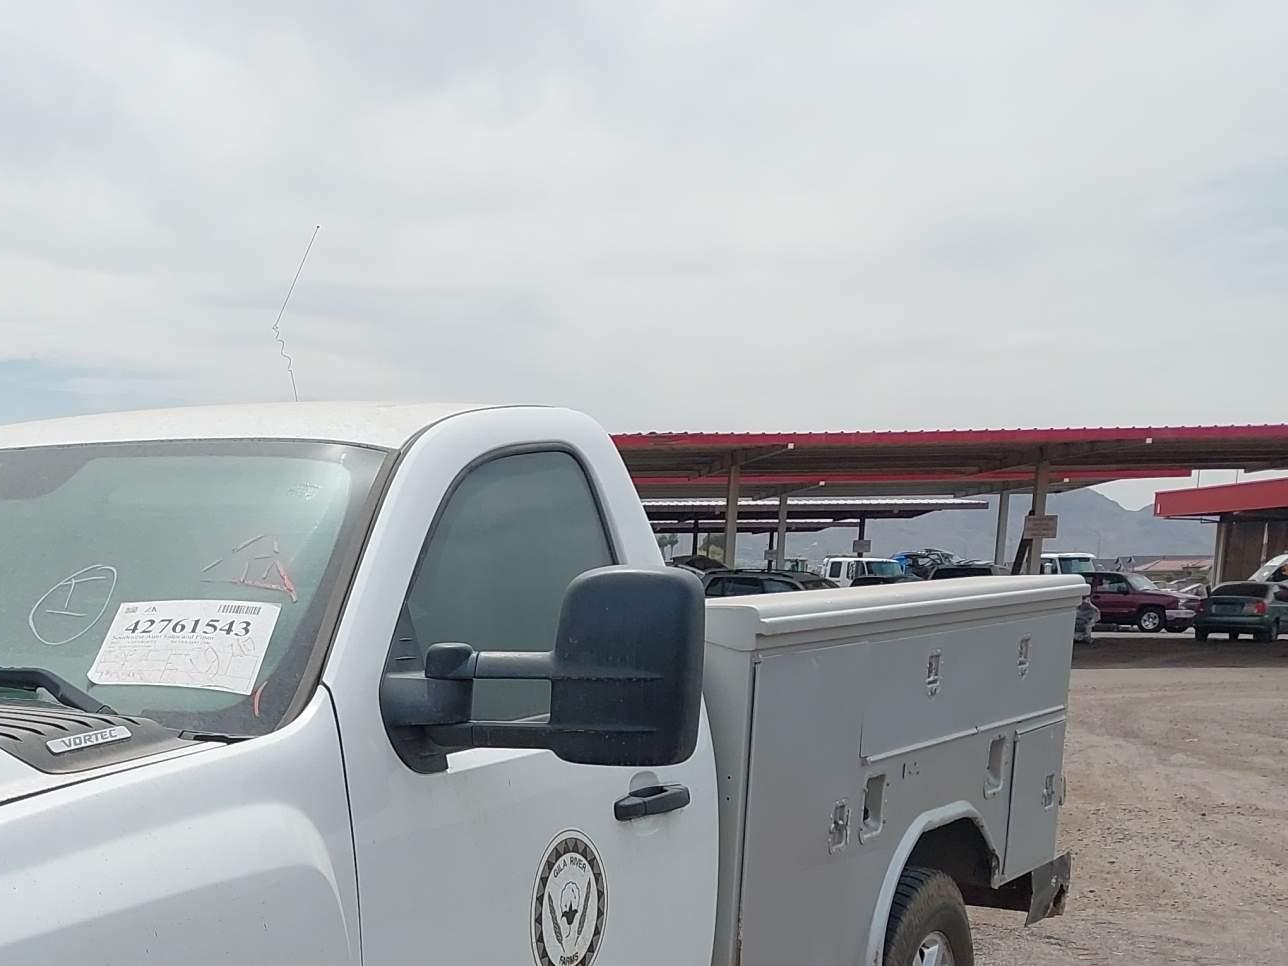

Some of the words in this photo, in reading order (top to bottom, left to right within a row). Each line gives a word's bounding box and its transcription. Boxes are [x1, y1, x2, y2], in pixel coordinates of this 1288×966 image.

[125, 618, 252, 637] 42761543
[62, 729, 118, 748] VORTEC
[553, 858, 568, 879] GILA
[569, 855, 587, 873] RIVER
[558, 951, 580, 966] FARMS
